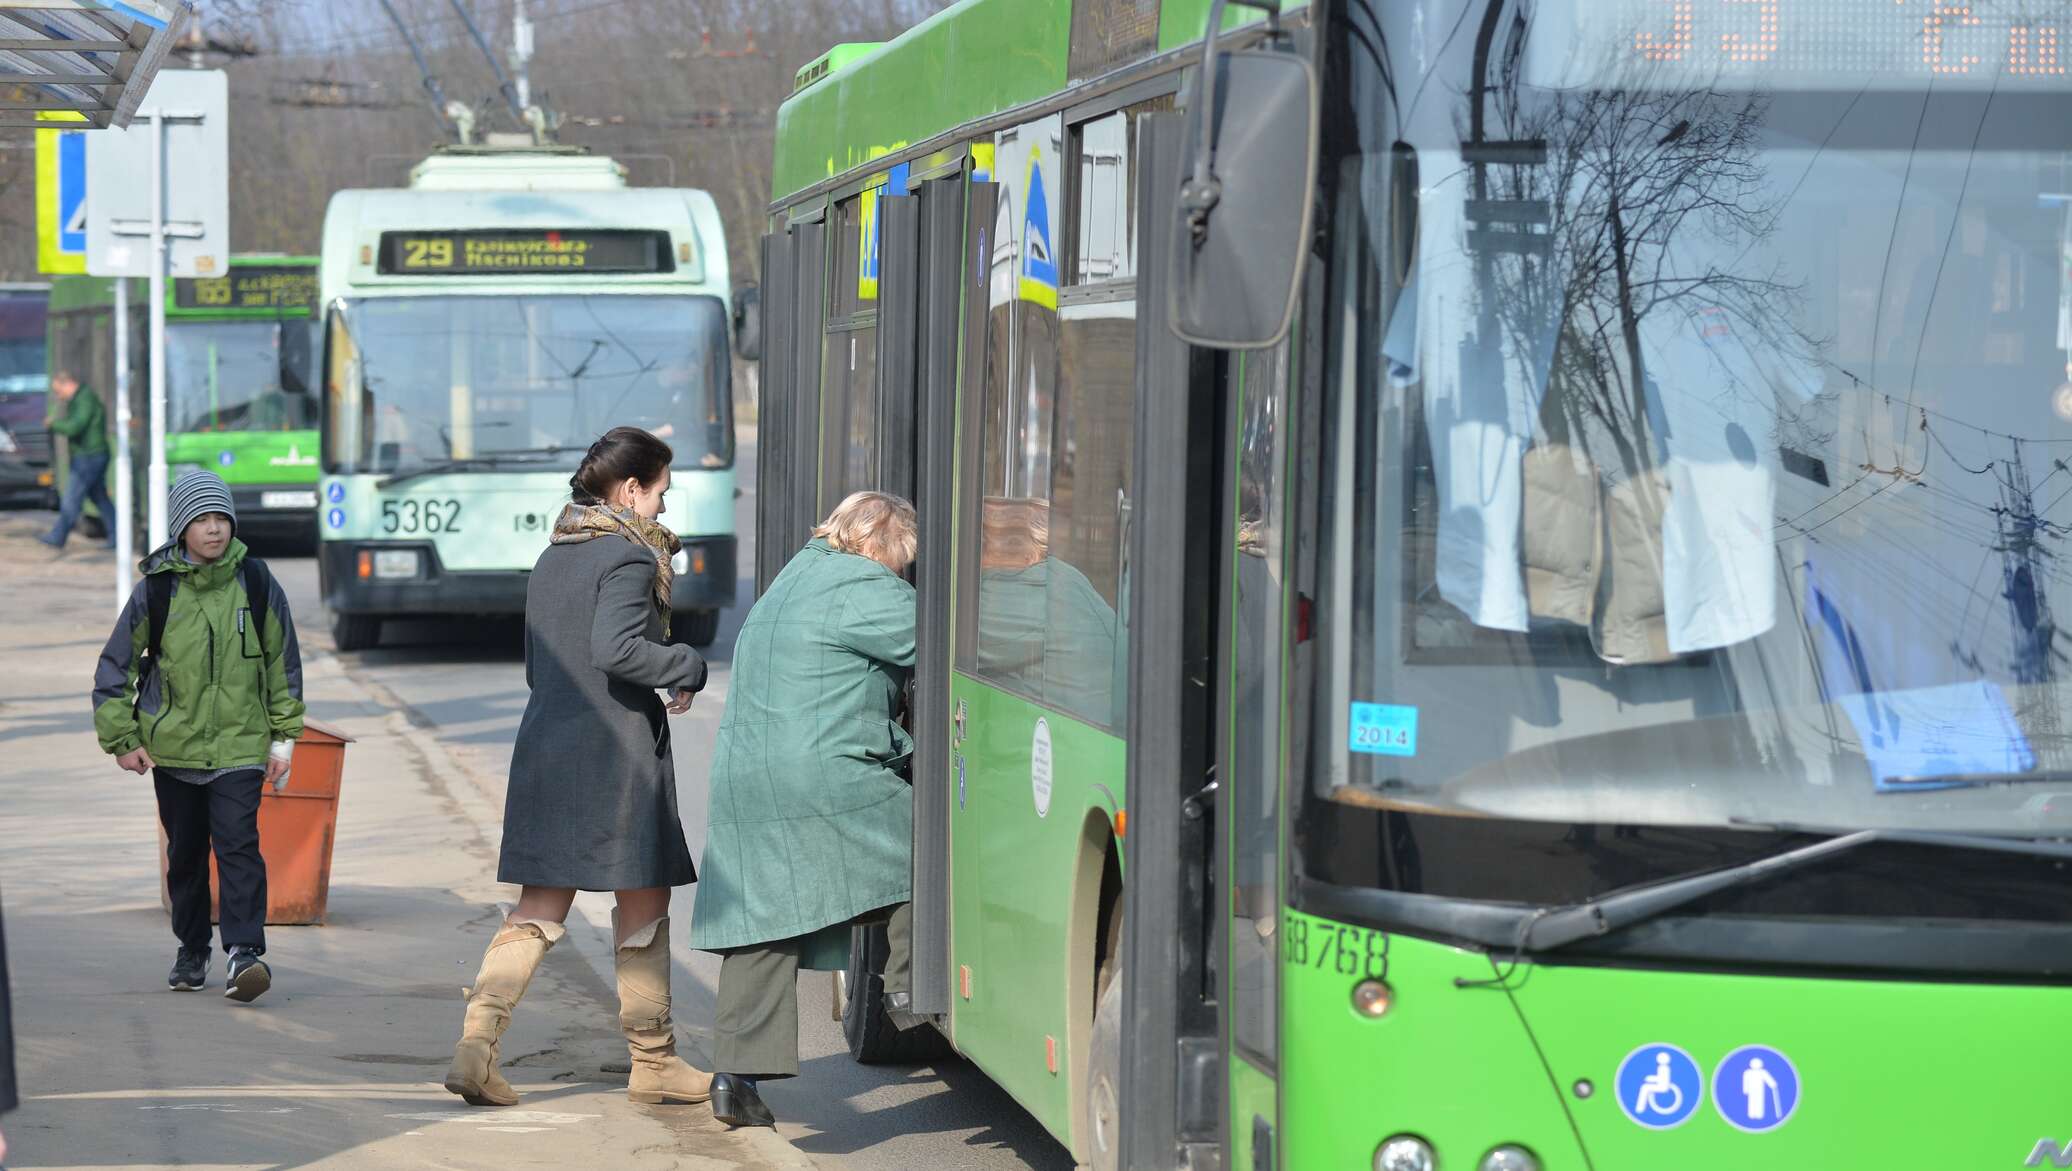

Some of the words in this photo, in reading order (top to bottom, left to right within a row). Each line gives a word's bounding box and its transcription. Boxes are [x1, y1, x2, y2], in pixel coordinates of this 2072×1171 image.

[404, 239, 453, 268] 29
[383, 499, 461, 533] 5362
[1358, 726, 1407, 745] 2014
